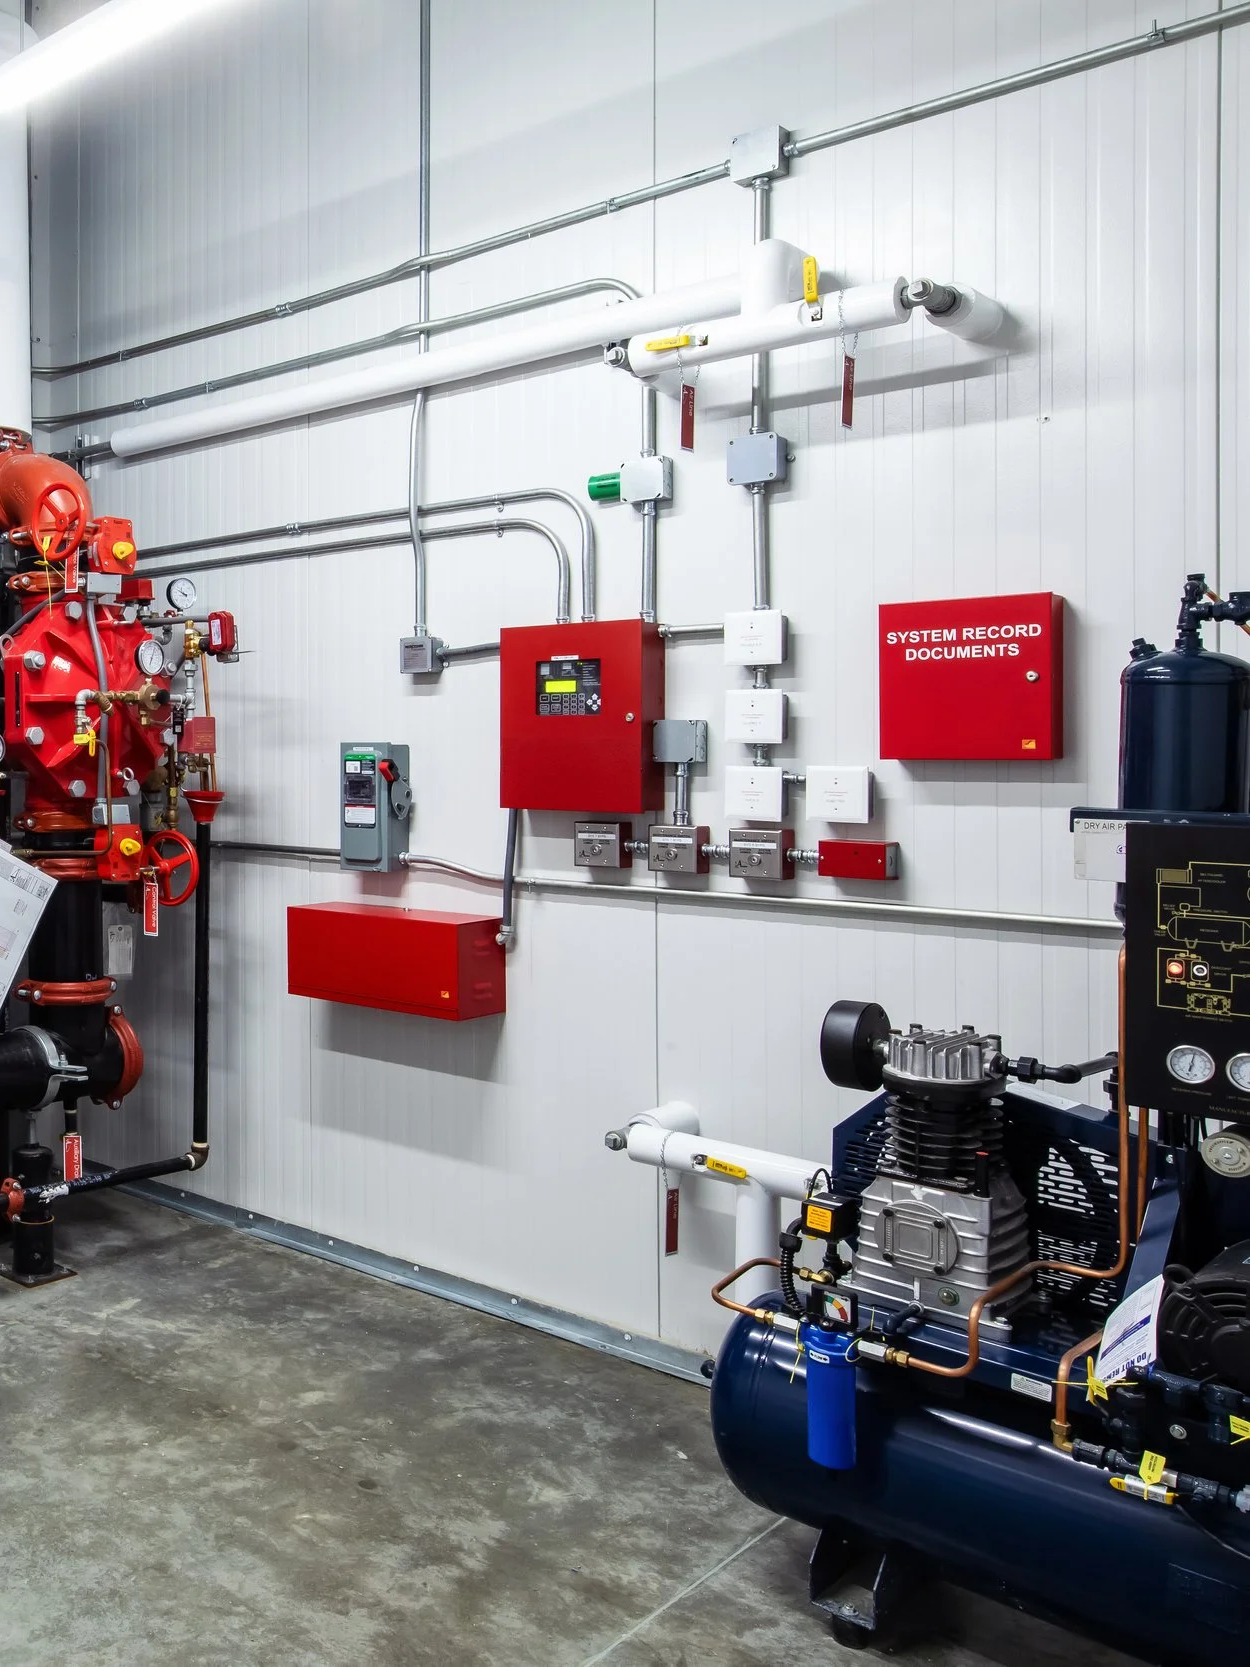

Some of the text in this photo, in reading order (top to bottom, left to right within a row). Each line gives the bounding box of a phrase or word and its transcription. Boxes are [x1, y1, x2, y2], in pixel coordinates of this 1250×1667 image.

[886, 623, 1042, 645] SYSTEM RECORD
[905, 643, 1020, 661] DOCUMENTS
[1084, 821, 1126, 831] DRY AIR PA
[1136, 1351, 1147, 1364] DO
